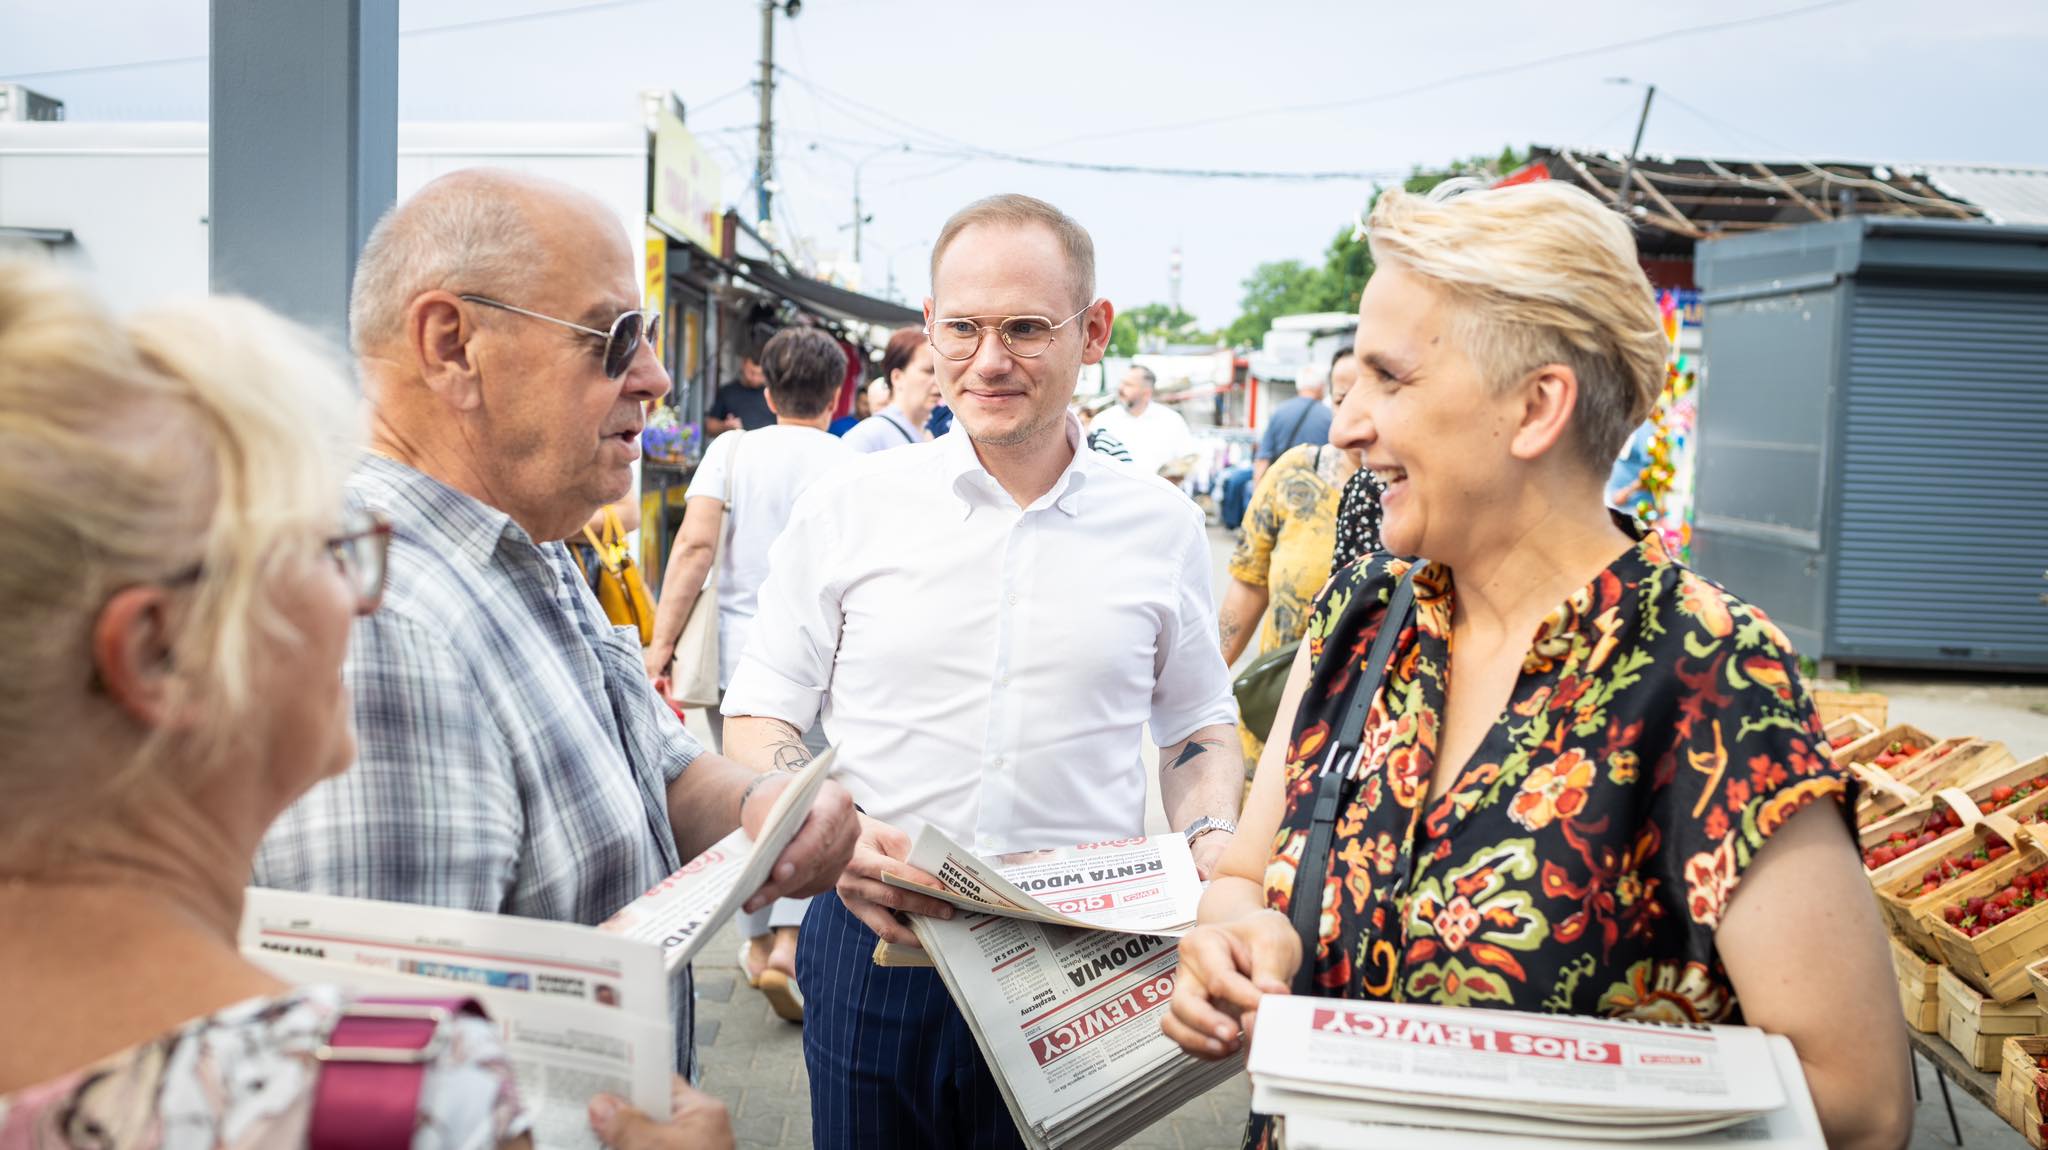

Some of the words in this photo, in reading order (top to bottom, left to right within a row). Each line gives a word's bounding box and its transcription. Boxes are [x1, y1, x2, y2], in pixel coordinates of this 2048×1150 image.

[941, 861, 982, 893] DEKADA
[1013, 872, 1084, 892] WDOW
[1089, 860, 1163, 879] RENTA
[1067, 933, 1162, 988] WDOWIA
[1020, 994, 1056, 1016] Bezpieczny
[1032, 988, 1054, 1002] Senior
[1042, 992, 1140, 1060] LEWICY
[1325, 1009, 1495, 1051] LEWICY
[1512, 1035, 1609, 1063] głos
